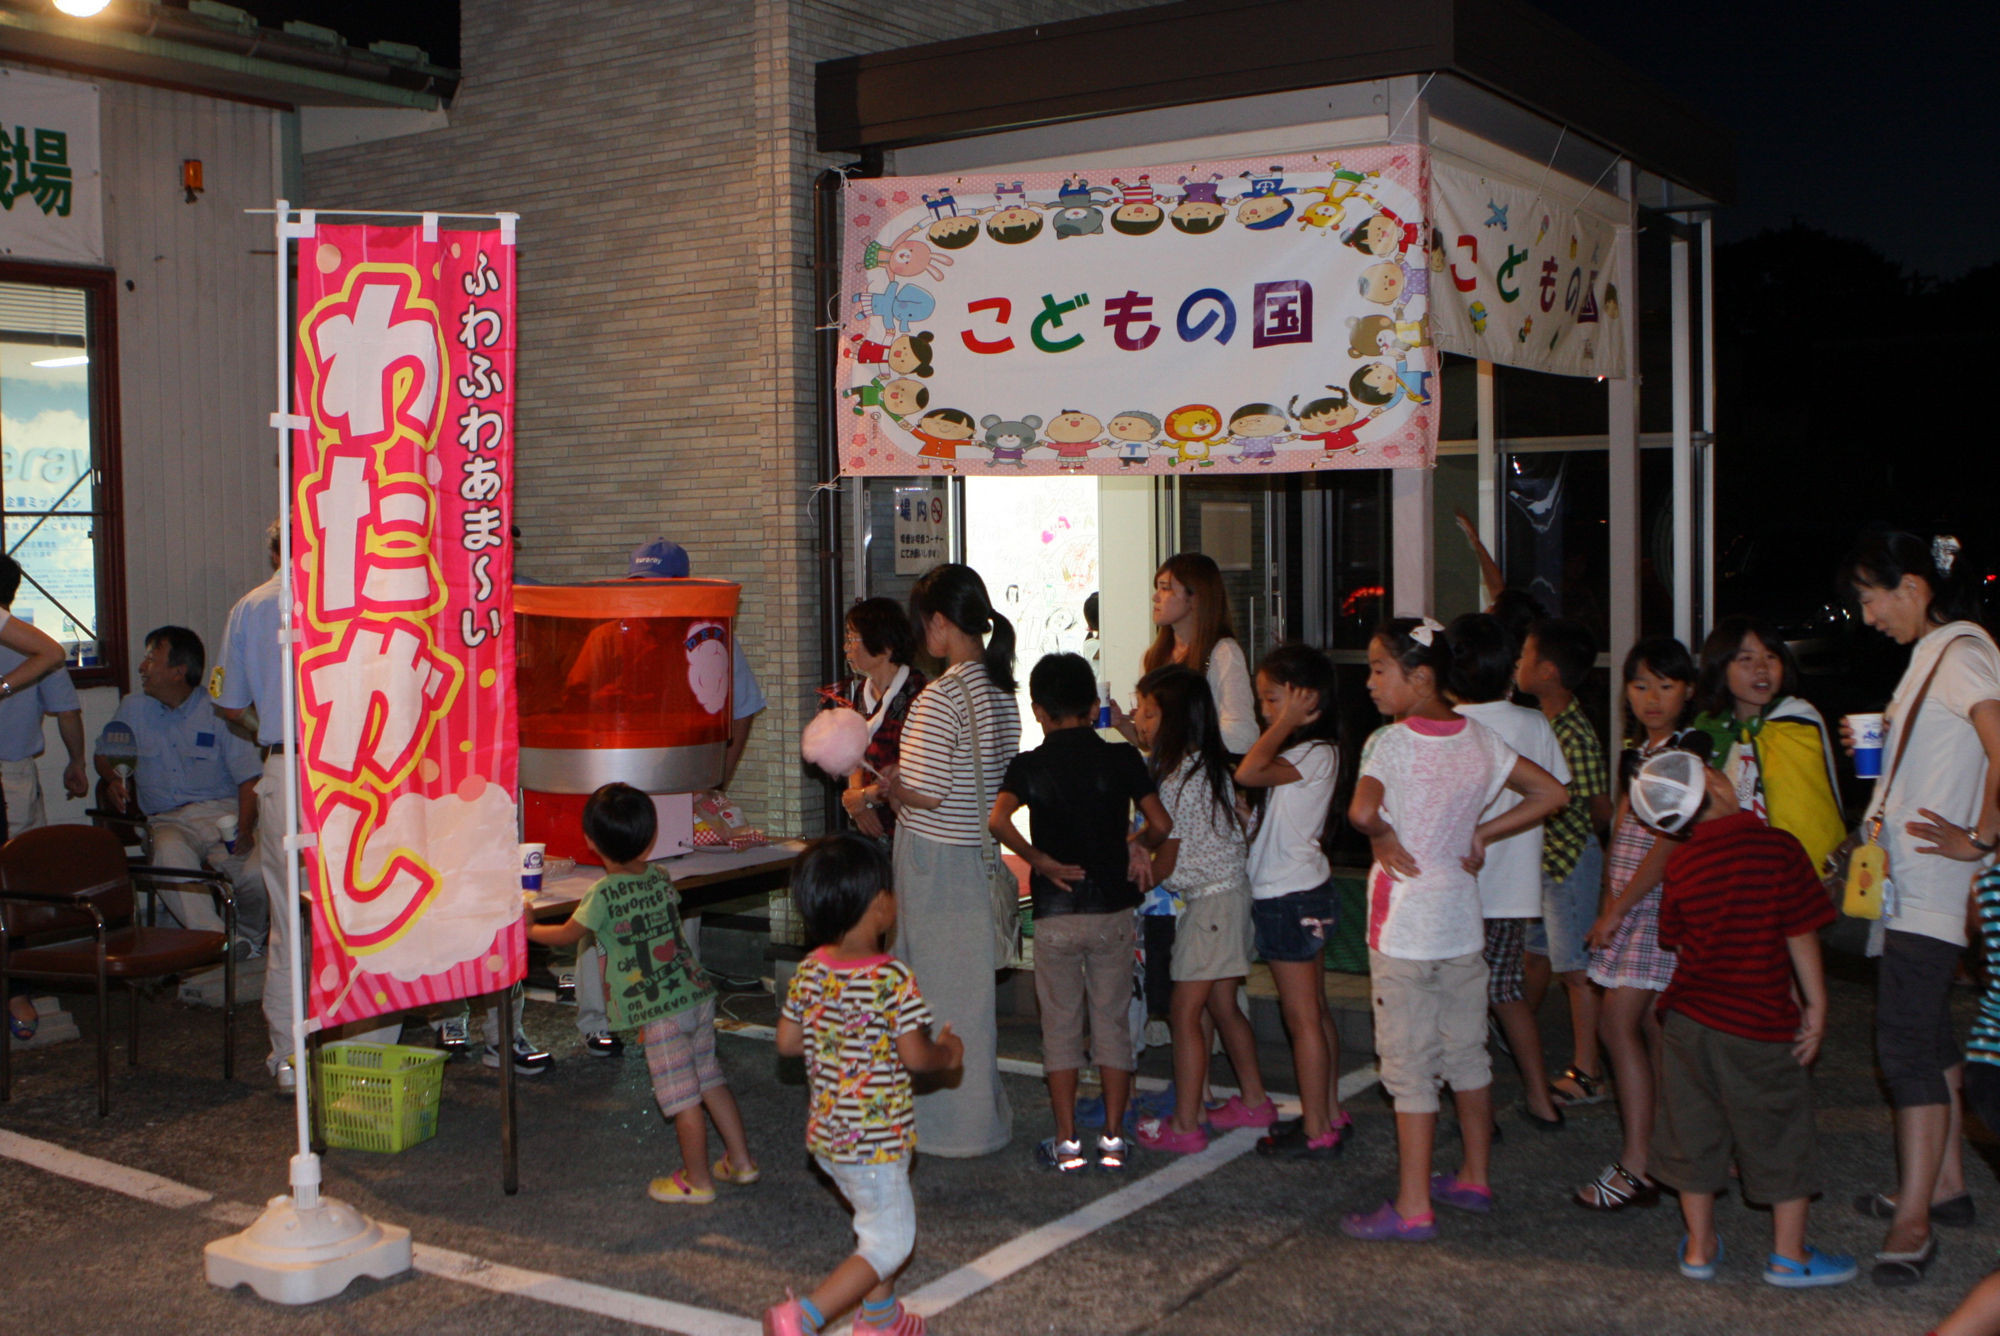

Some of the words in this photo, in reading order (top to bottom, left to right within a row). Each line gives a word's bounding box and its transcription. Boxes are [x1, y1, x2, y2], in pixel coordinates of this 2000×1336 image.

[959, 279, 1314, 354] こどもの国
[308, 280, 448, 940] わたがし
